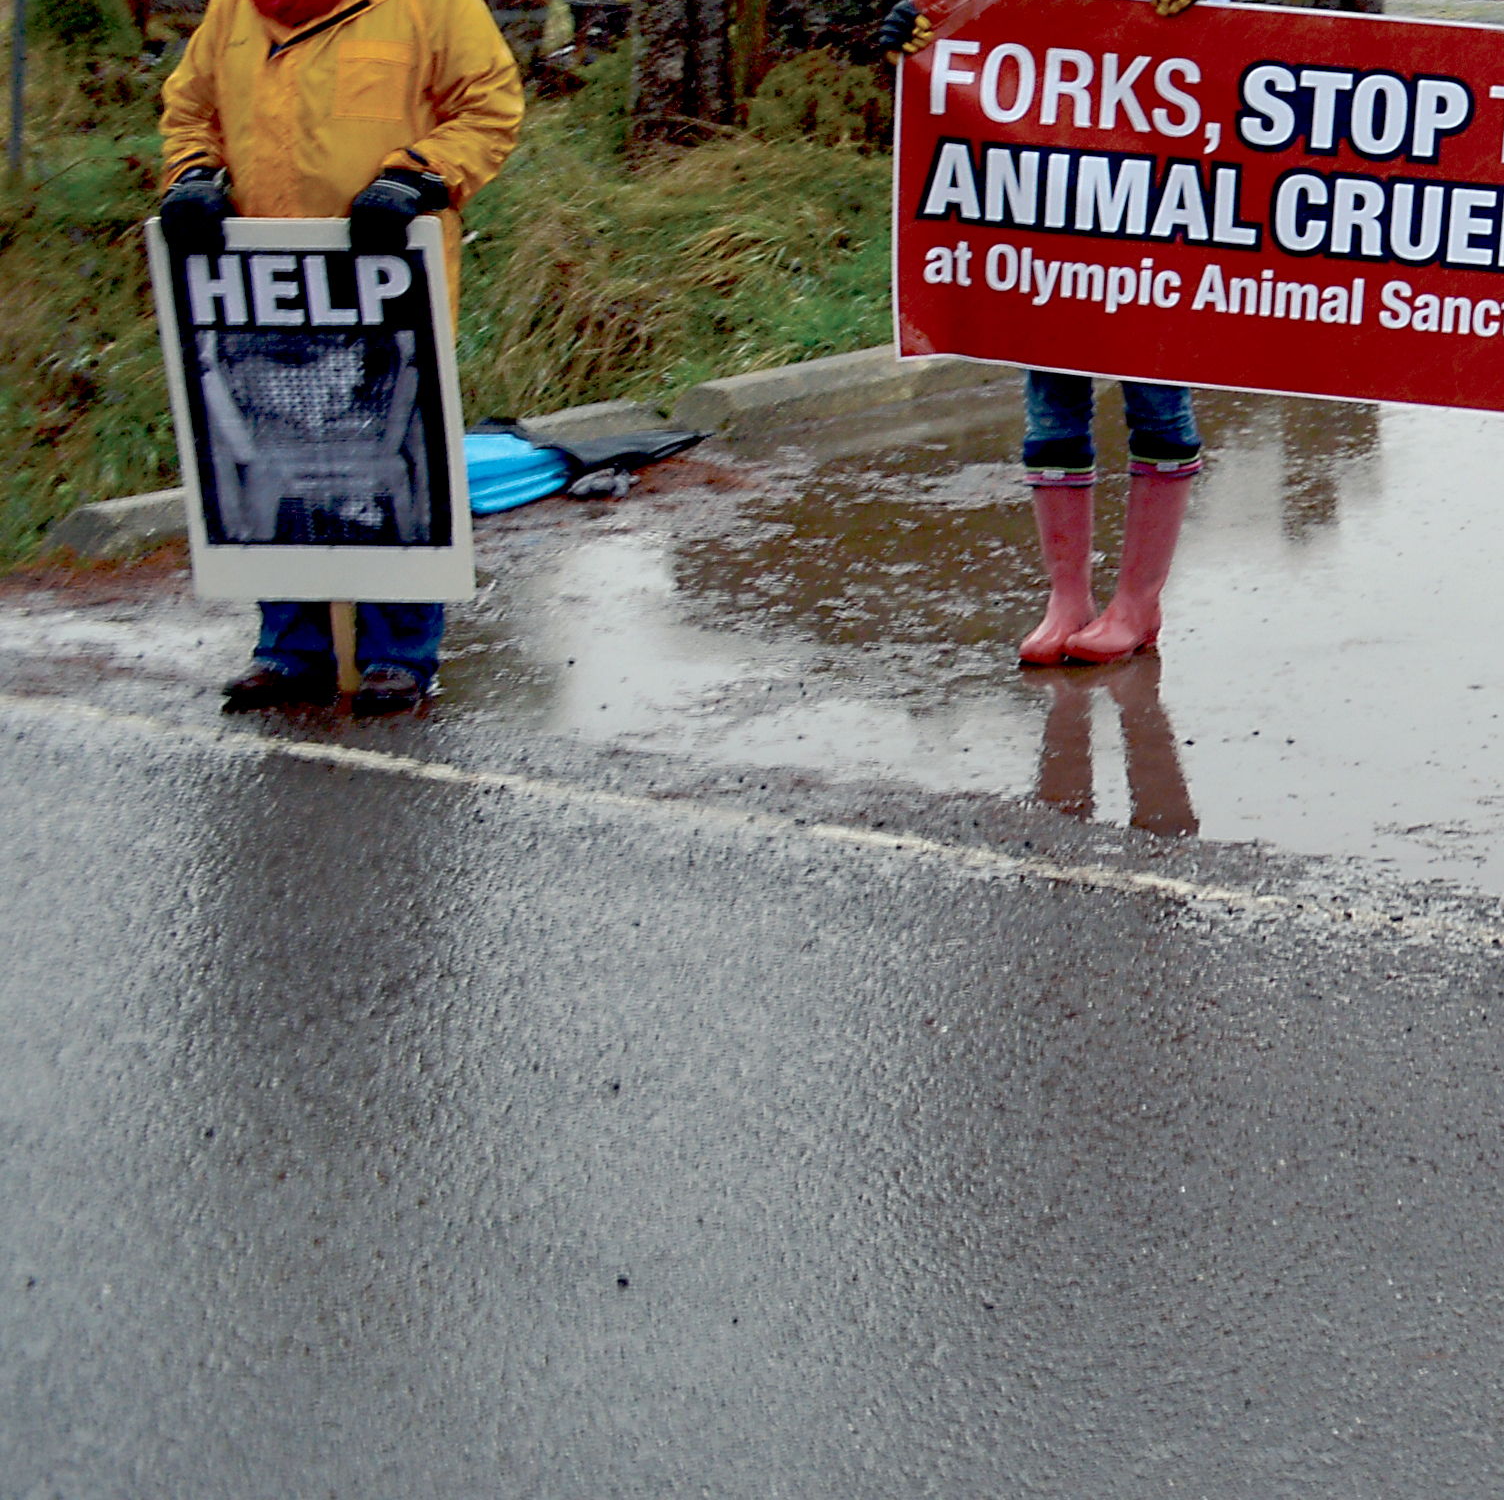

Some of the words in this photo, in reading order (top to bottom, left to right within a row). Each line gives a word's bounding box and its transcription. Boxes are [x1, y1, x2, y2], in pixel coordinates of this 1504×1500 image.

[929, 39, 1221, 155] FORKS,
[1241, 65, 1470, 156] STOP
[924, 143, 1258, 247] ANIMAL
[186, 255, 412, 326] HELP
[924, 245, 971, 285] at
[986, 243, 1181, 313] Olympic
[1194, 264, 1363, 325] Animal
